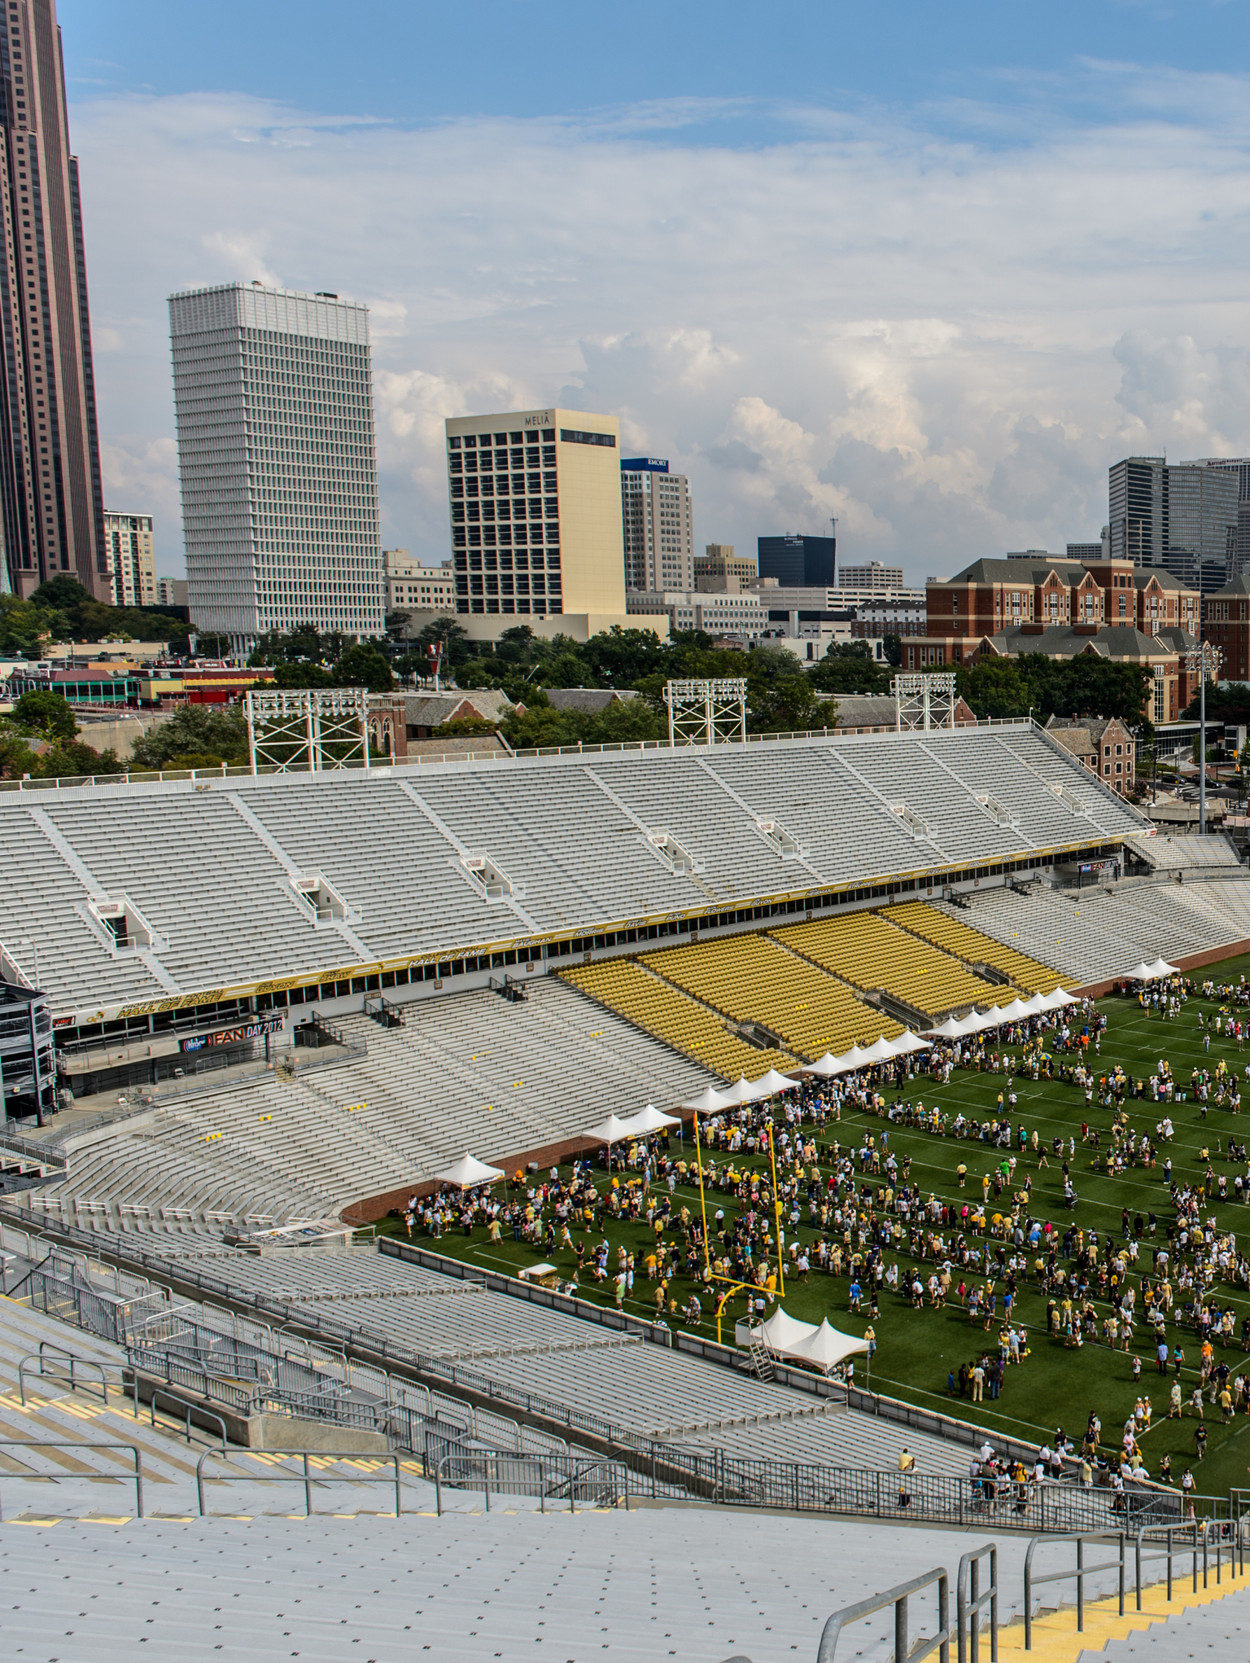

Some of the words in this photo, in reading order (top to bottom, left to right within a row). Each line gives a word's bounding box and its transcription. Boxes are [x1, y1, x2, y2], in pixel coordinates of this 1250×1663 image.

[647, 458, 666, 467] EMORY
[511, 937, 553, 949] BAUGHAN
[408, 957, 437, 968] HALL
[439, 953, 455, 963] OF
[456, 948, 487, 960] FAME
[116, 1005, 156, 1018] HALL
[158, 1001, 180, 1012] OF
[181, 993, 222, 1008] FAME
[213, 1028, 245, 1046] FAN
[246, 1024, 263, 1038] DAY
[263, 1020, 283, 1034] 2012
